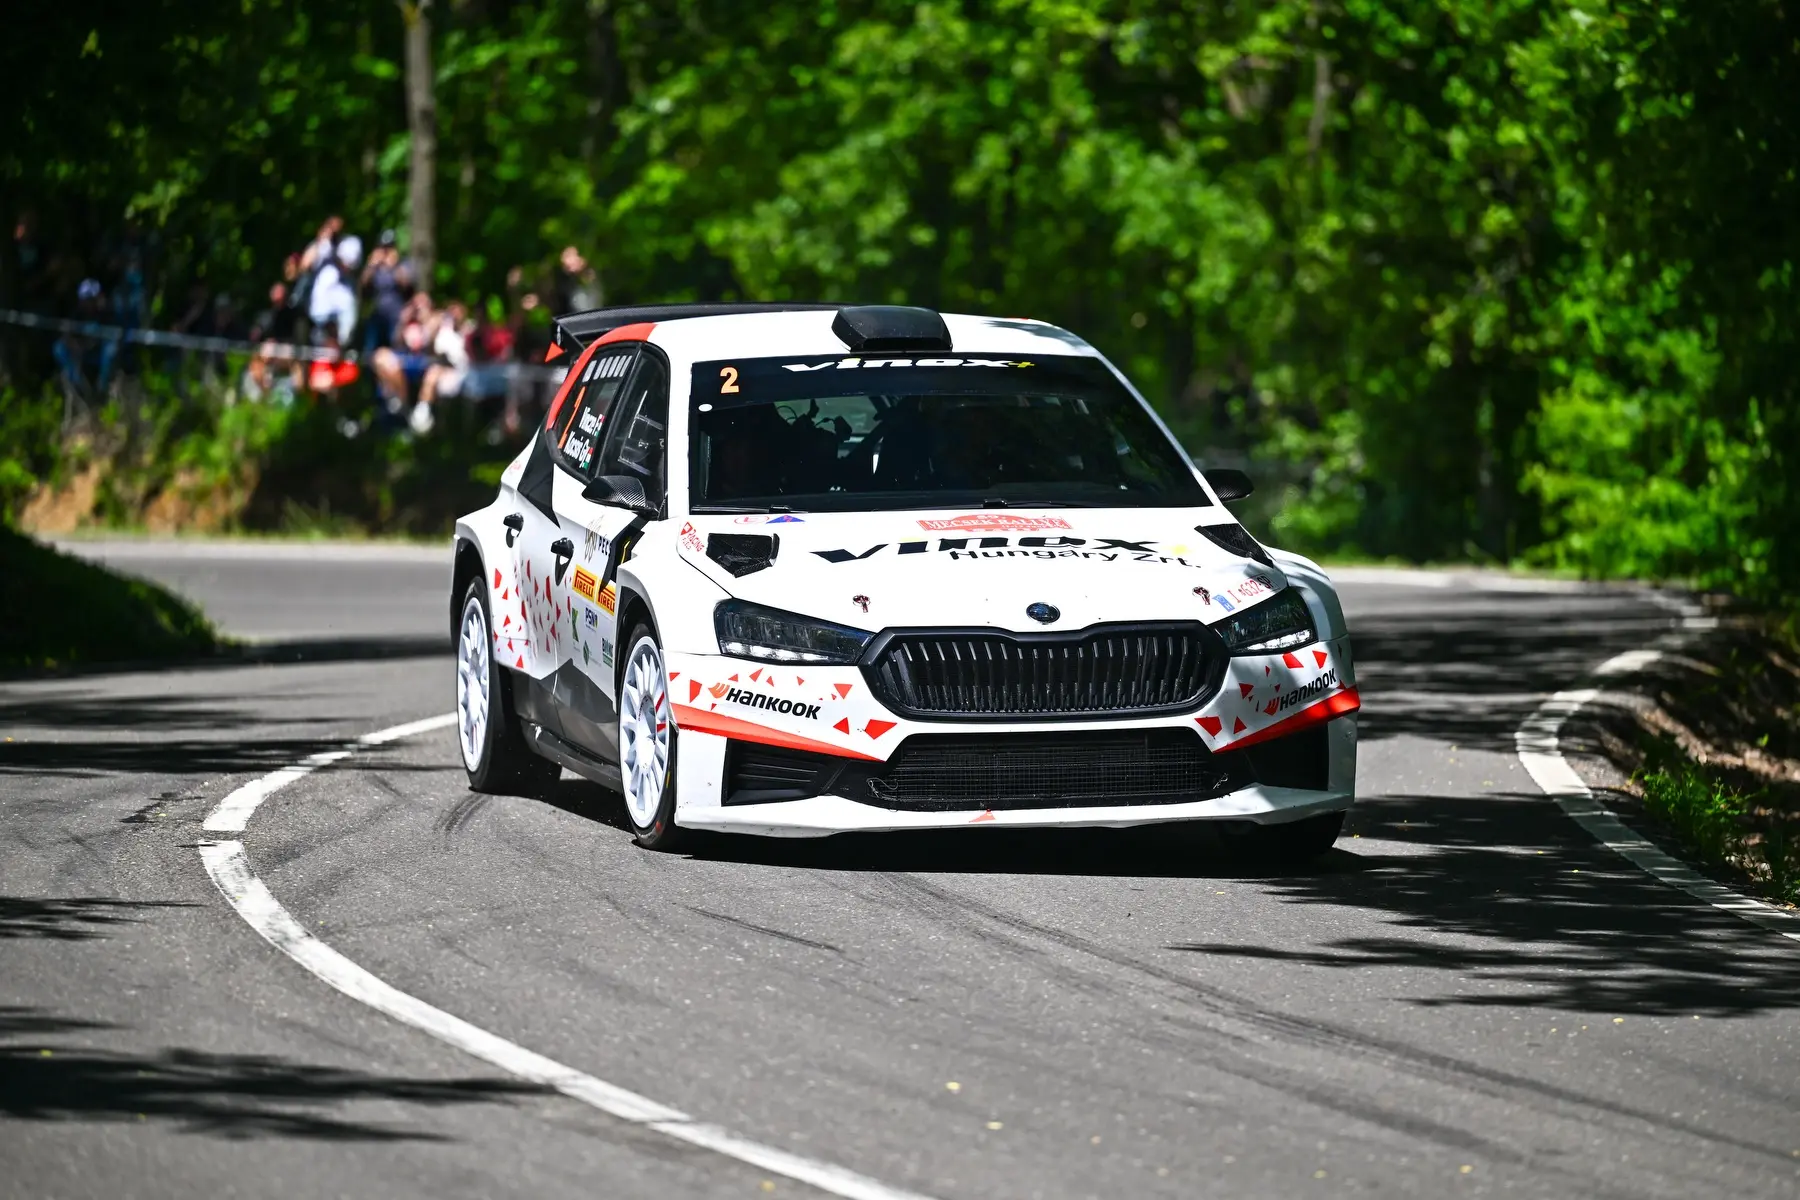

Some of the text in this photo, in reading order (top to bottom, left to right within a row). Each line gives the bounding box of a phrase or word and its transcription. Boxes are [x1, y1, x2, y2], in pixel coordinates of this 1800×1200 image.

[719, 366, 740, 394] 2
[926, 518, 994, 531] MECSEK
[998, 517, 1069, 529] RALLYE
[687, 528, 705, 552] RACING
[949, 548, 1202, 569] Hungary Zrt.
[574, 569, 595, 598] PIRELLI
